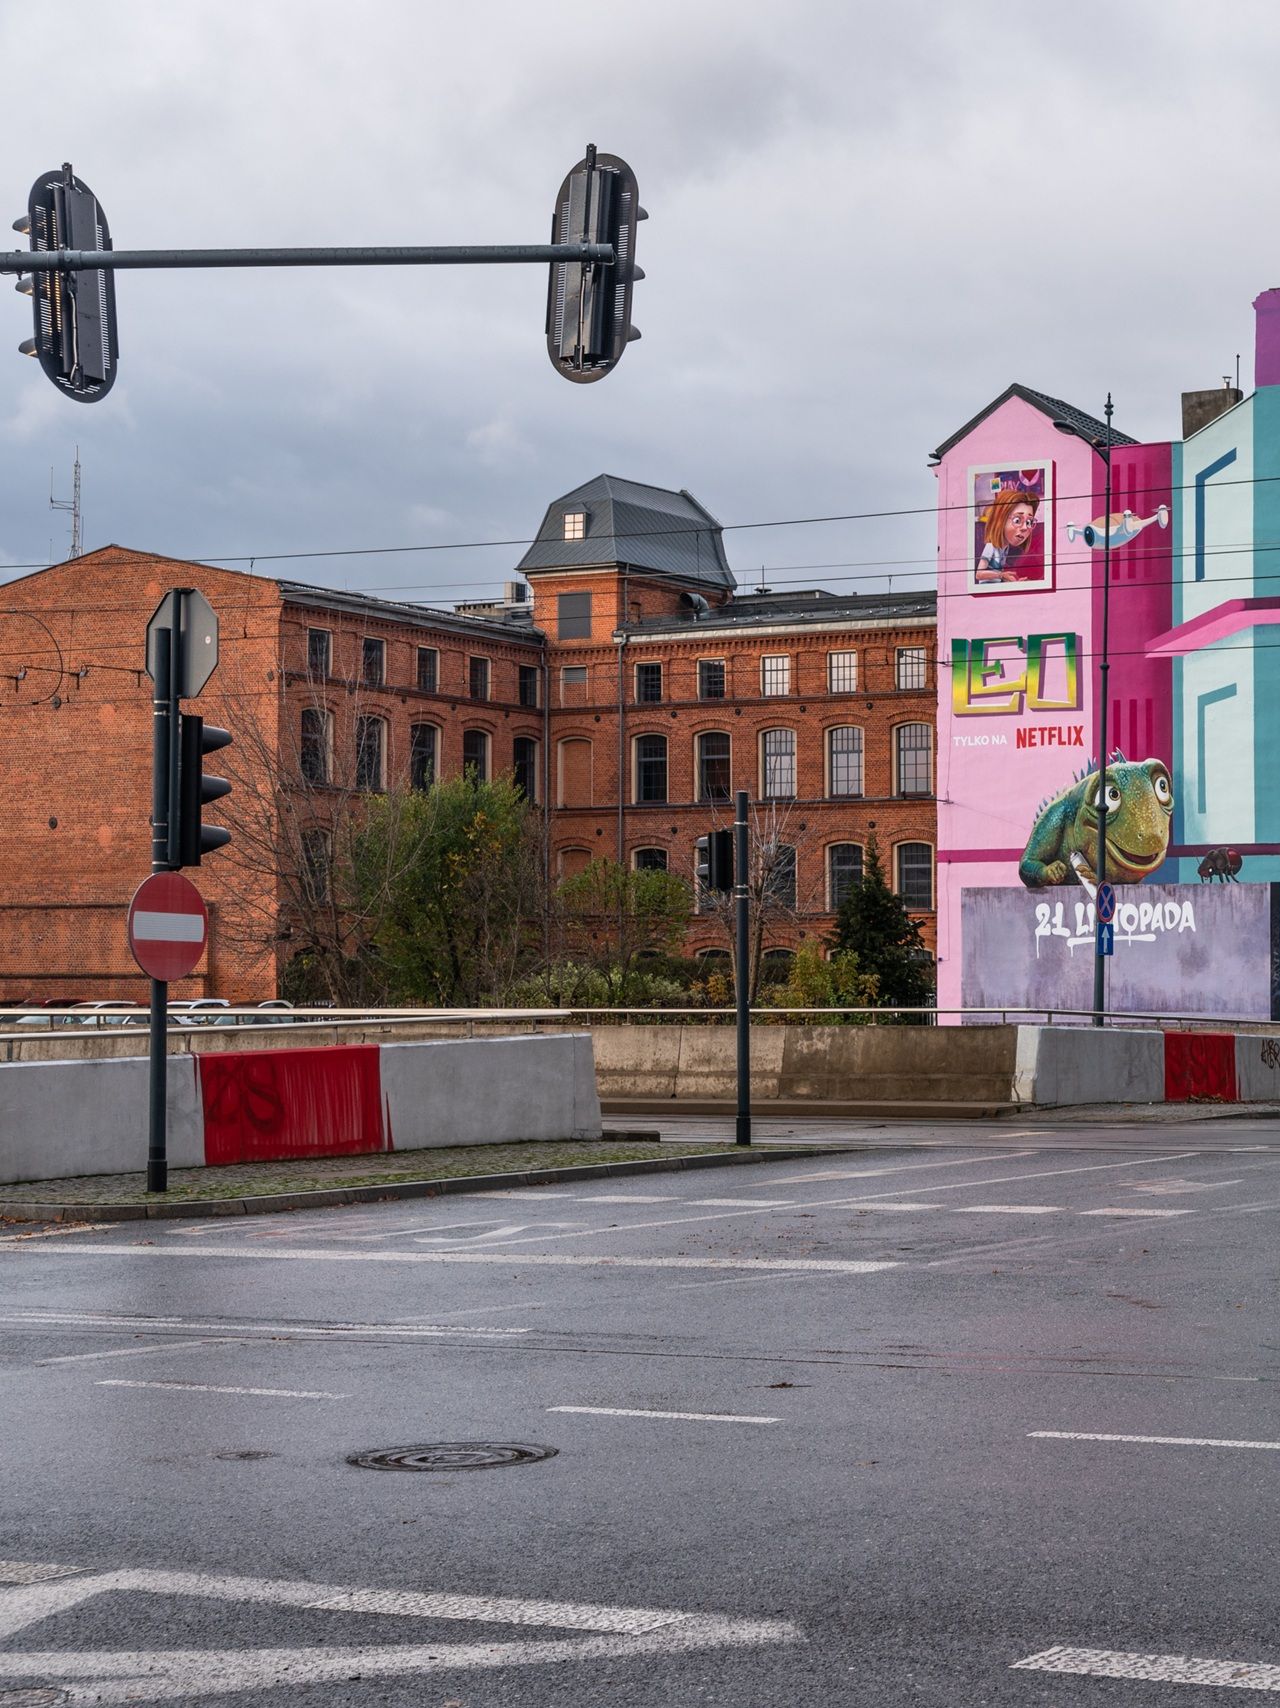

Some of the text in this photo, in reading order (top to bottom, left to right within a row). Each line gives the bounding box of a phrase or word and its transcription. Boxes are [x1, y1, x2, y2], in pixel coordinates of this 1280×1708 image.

[951, 632, 1081, 715] LEO
[953, 726, 1084, 749] TYLKO NA NETFLIX
[1035, 901, 1196, 939] 21 LITOPADA
